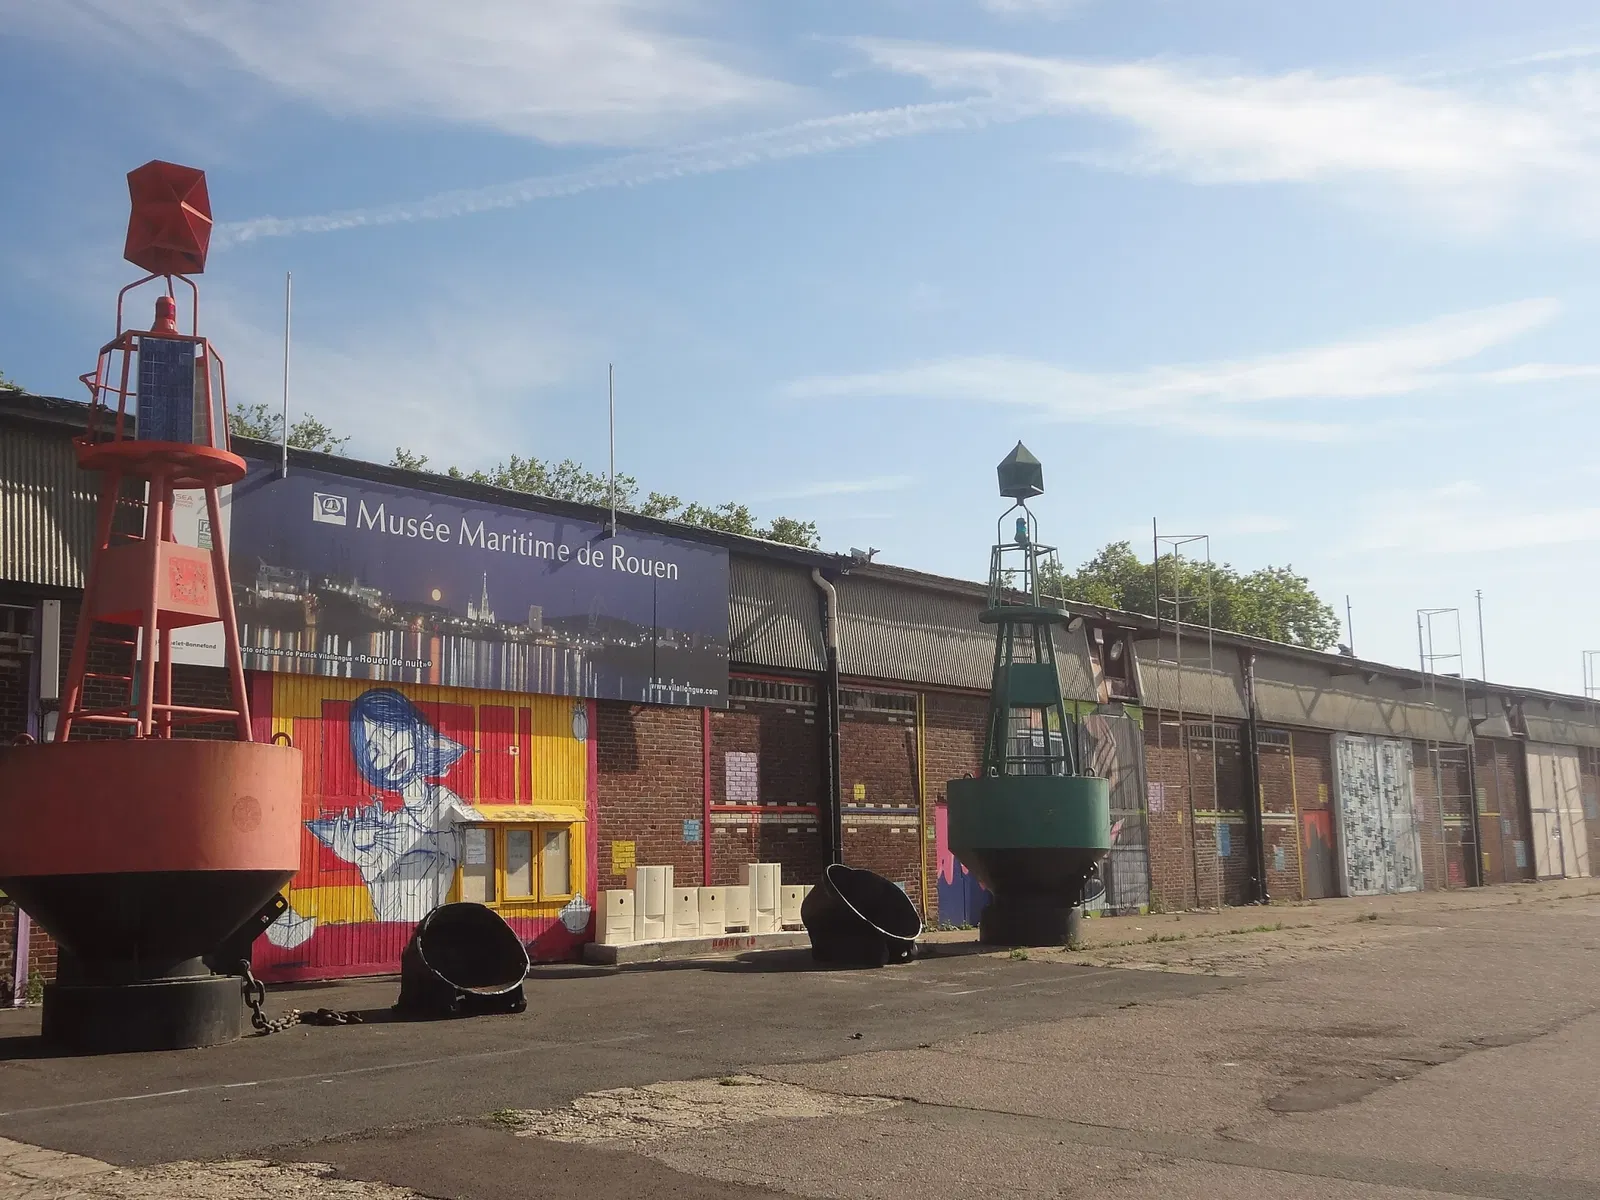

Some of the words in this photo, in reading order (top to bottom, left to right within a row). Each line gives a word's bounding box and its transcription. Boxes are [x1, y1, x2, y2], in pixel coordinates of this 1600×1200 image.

[356, 499, 450, 543] Musée
[458, 517, 570, 563] Maritime
[577, 541, 604, 568] de
[612, 544, 678, 580] Rouen
[239, 646, 253, 654] oto
[255, 646, 284, 656] originale
[285, 649, 293, 657] de
[295, 650, 318, 659] Patrick
[391, 657, 403, 667] de
[648, 683, 719, 696] www.vilallongue.com
